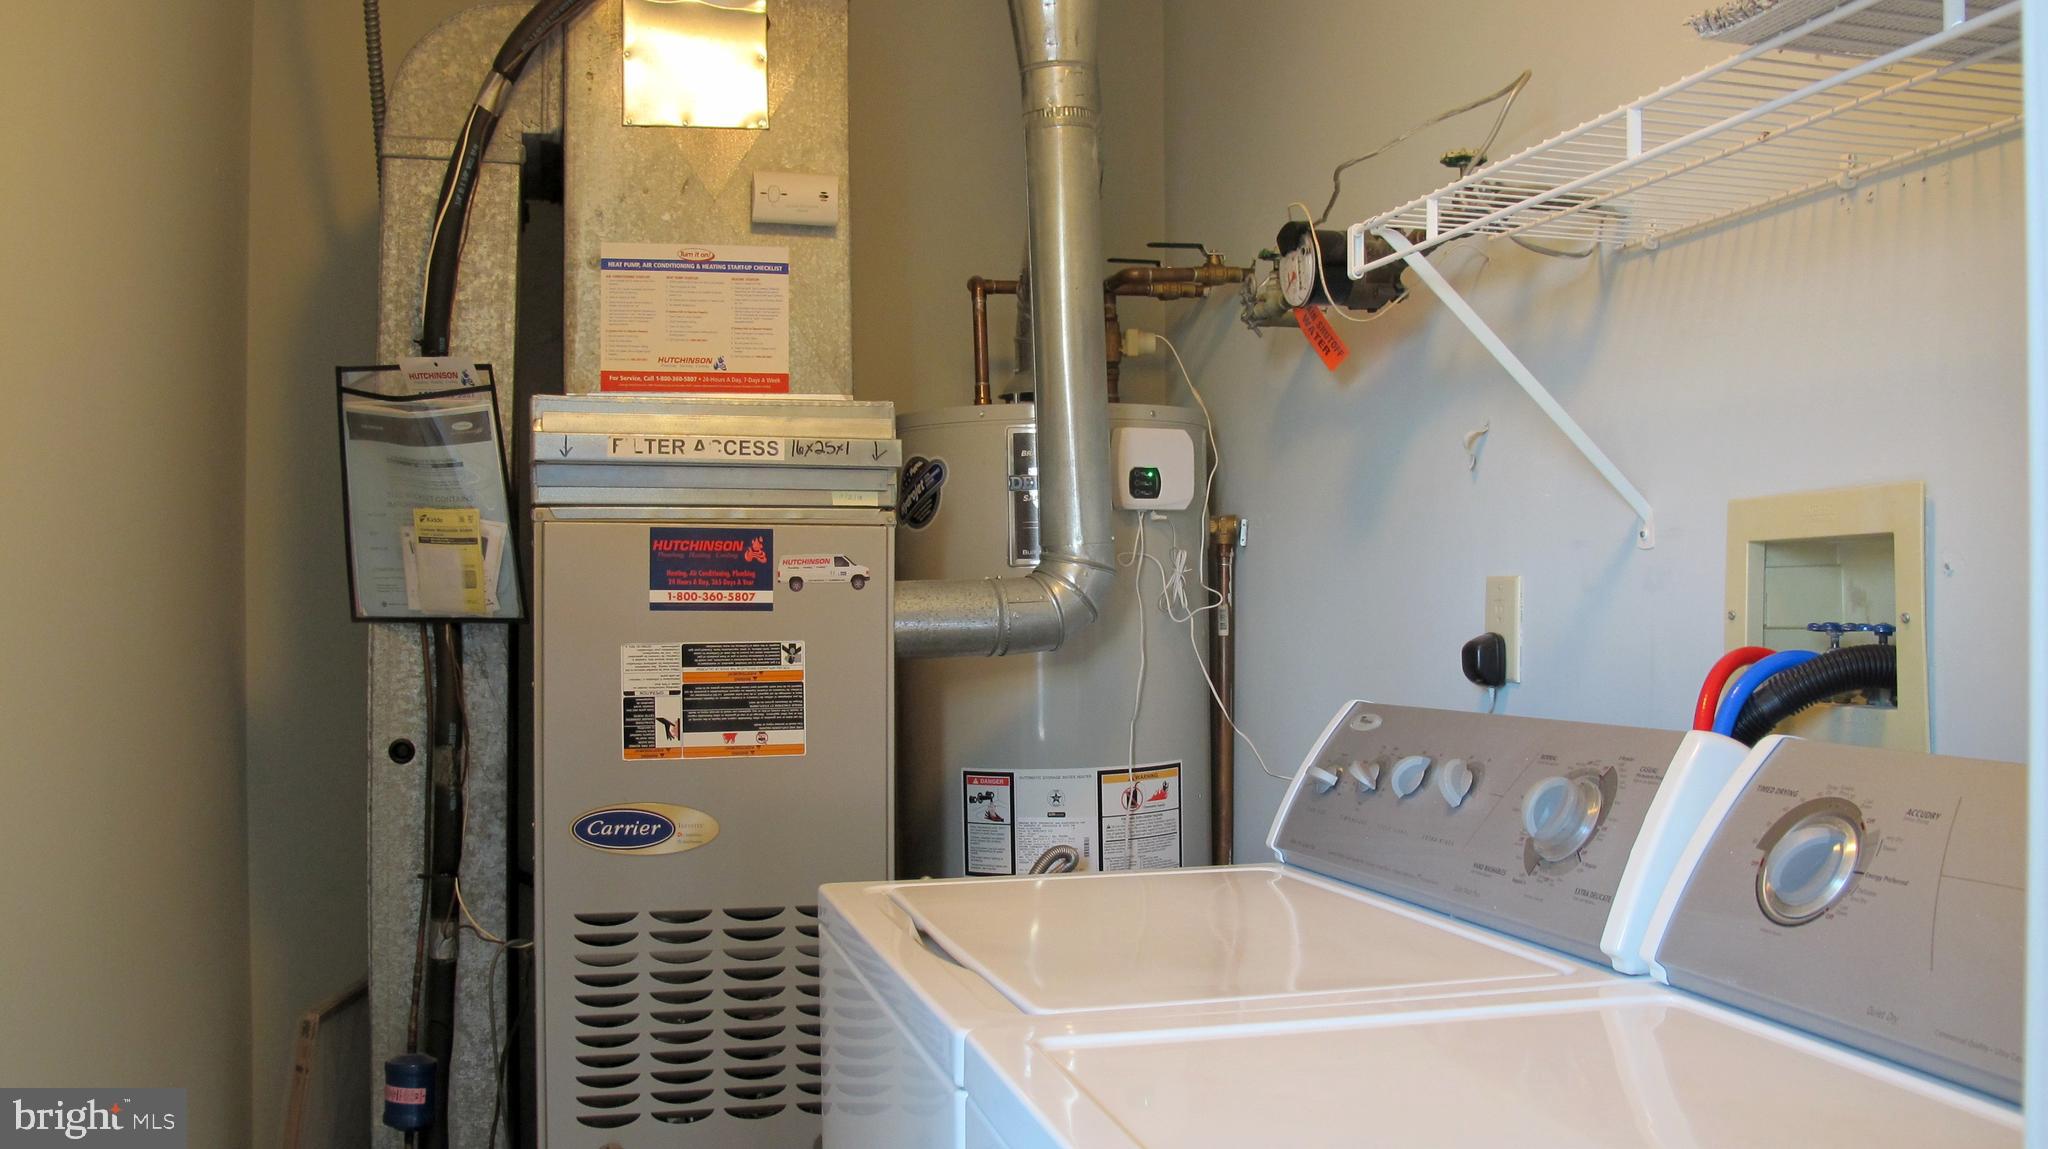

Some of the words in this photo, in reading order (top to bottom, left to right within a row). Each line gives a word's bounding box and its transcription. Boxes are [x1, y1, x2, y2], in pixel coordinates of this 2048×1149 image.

[679, 250, 693, 259] Turn
[693, 250, 700, 259] it
[700, 250, 712, 259] on!
[607, 261, 622, 269] HEAT
[623, 261, 641, 269] PUMP,
[653, 262, 695, 270] CONDITIONING
[701, 263, 726, 271] HEATING
[1302, 313, 1331, 356] WATER
[1316, 320, 1345, 357] SHUTOFF
[657, 356, 713, 364] HUTCHINSON
[408, 371, 459, 380] HUTCHINSON
[612, 437, 685, 454] FLTER
[652, 539, 745, 551] HUTCHINSON
[782, 558, 831, 567] HUTCHINSON
[667, 591, 757, 602] 1-800-360-5807
[1773, 786, 1799, 798] DRYING
[1905, 807, 1943, 821] ACCUDRY
[586, 819, 661, 836] Carrier
[1864, 871, 1883, 882] Energy
[1574, 887, 1590, 899] EXTRA
[1588, 890, 1614, 903] DELICATE
[1866, 1005, 1886, 1019] Quiet
[1885, 1010, 1899, 1024] Dry
